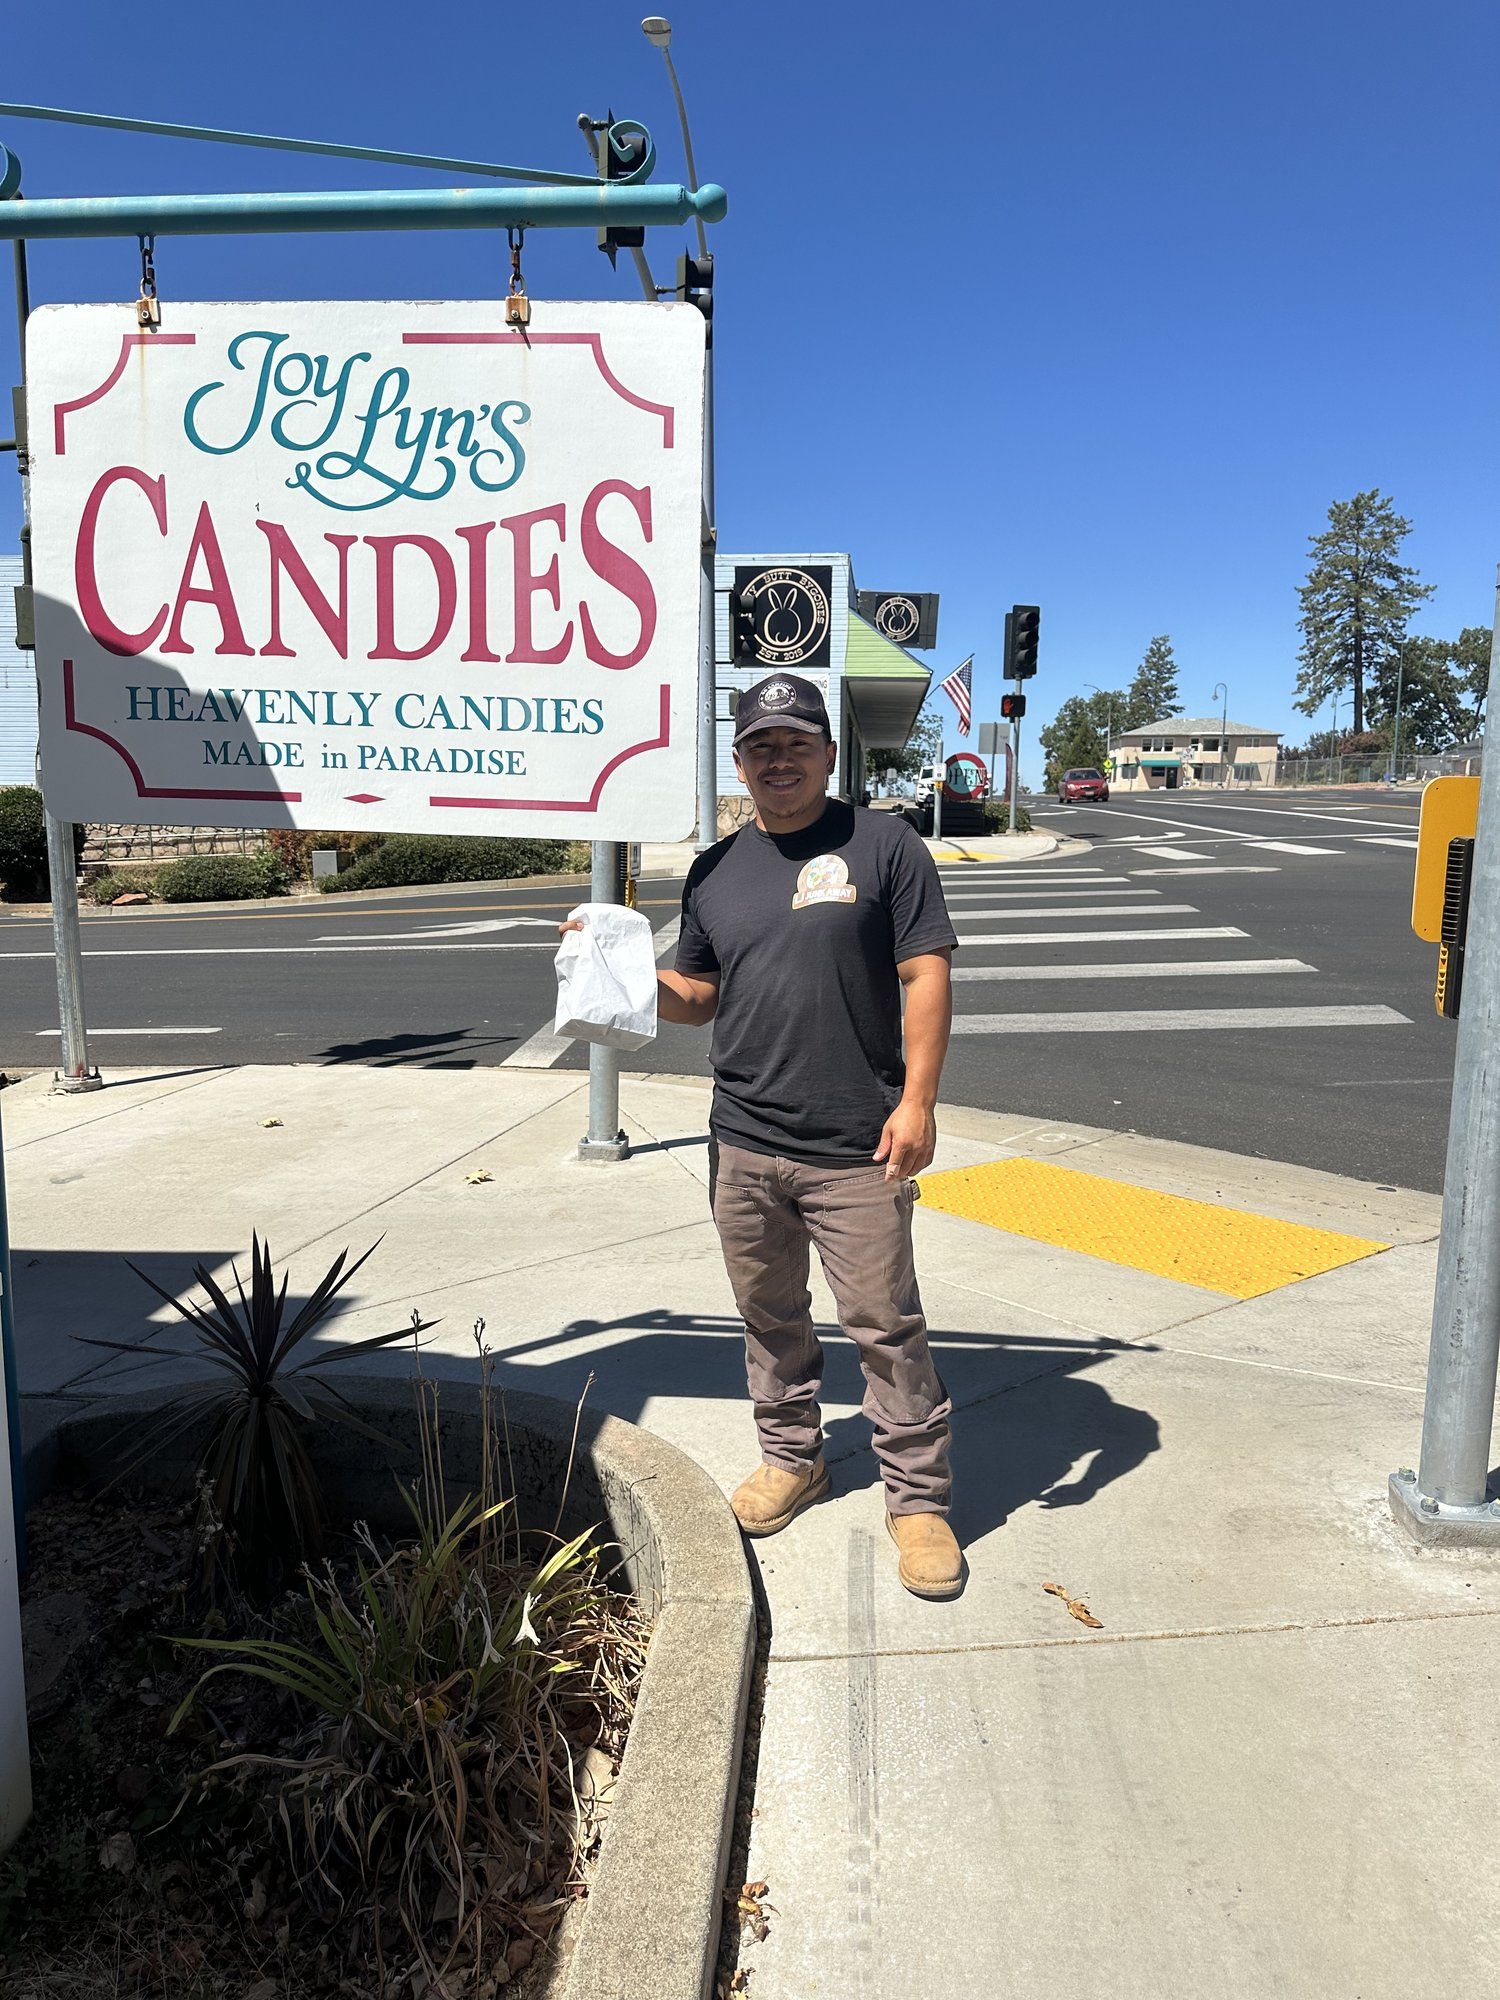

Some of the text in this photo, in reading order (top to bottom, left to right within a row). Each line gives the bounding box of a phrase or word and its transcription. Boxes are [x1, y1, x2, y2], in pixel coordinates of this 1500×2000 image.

[184, 330, 372, 456] Joy
[74, 465, 657, 670] CANDIES
[763, 572, 826, 625] BUTT BYGONES
[758, 647, 804, 661] EST 2019
[126, 686, 605, 735] HEAVENLY CANDIES
[202, 740, 528, 776] MADE in PARADISE
[827, 887, 852, 899] AWAY
